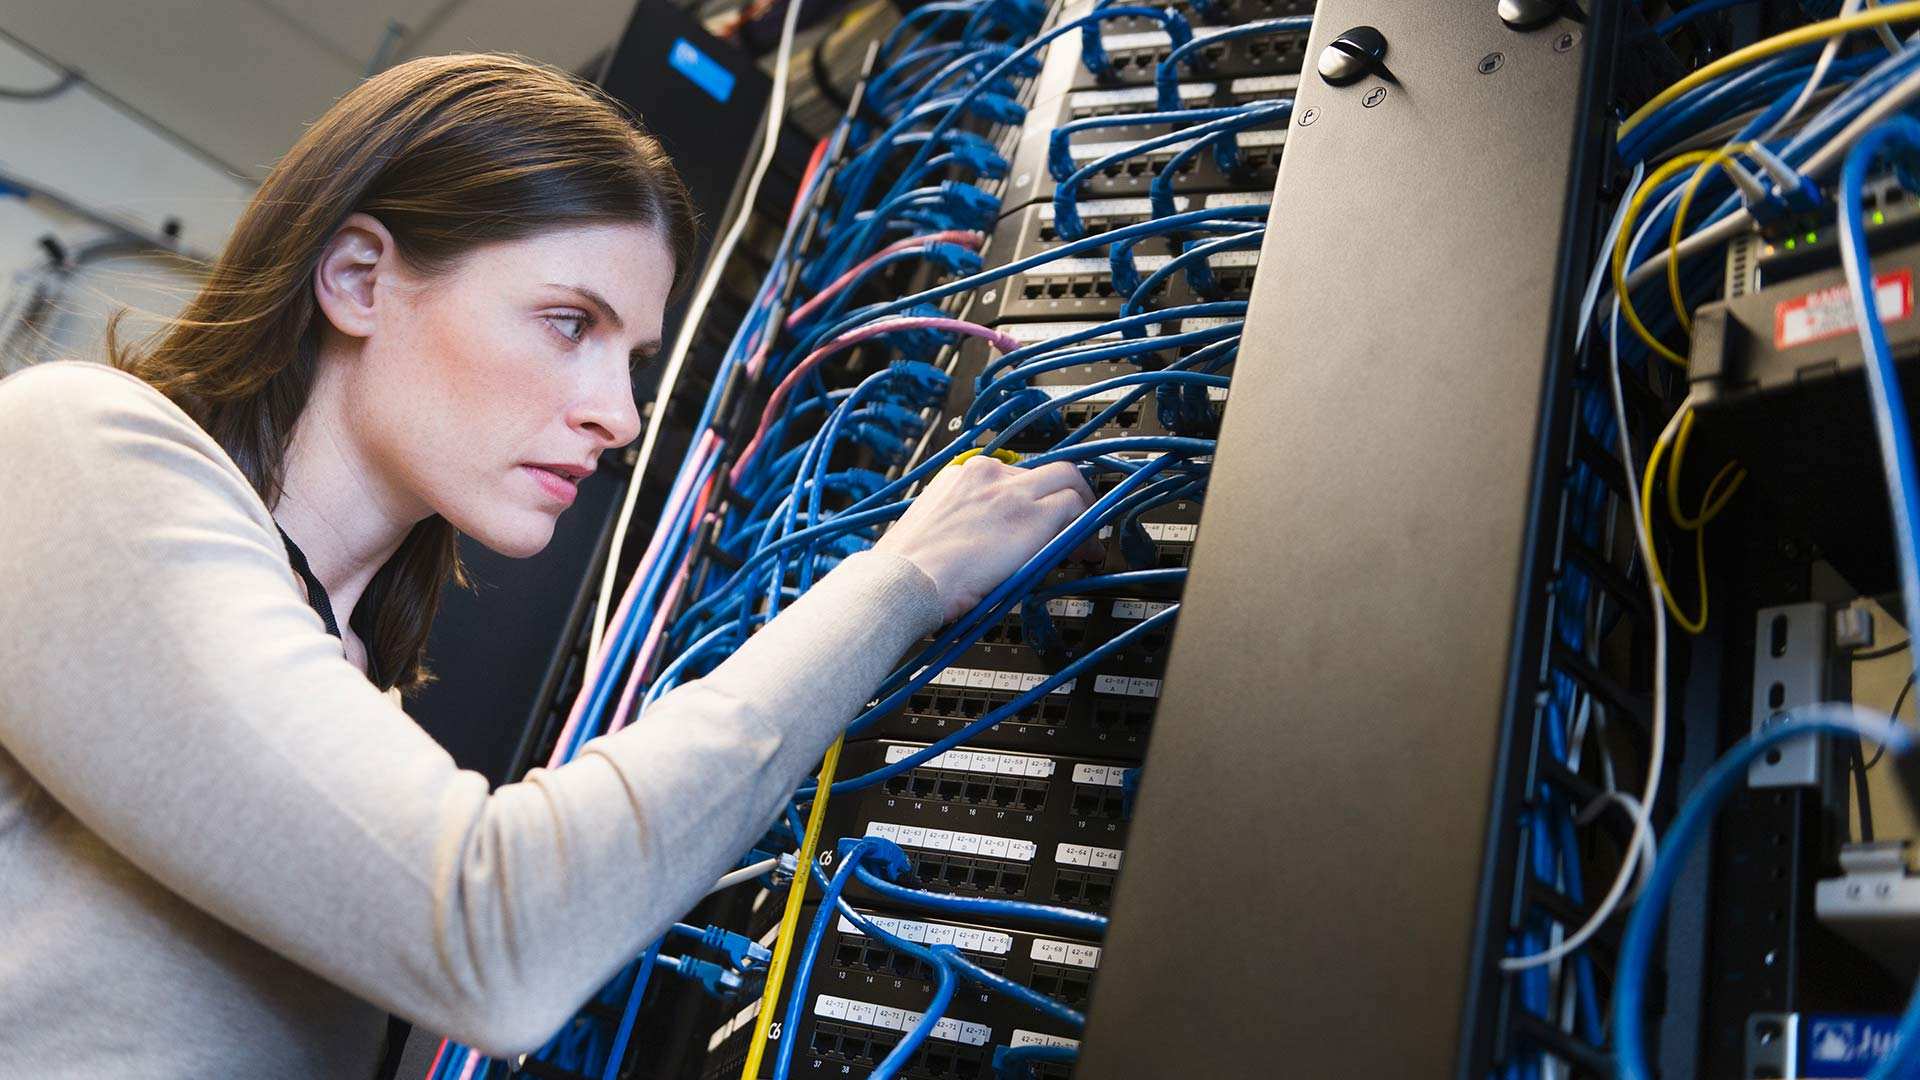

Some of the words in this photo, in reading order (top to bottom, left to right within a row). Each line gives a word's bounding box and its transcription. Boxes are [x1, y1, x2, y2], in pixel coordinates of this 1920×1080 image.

[819, 849, 833, 866] C6
[865, 975, 874, 984] 14
[893, 980, 902, 989] 15
[767, 1022, 782, 1040] C6
